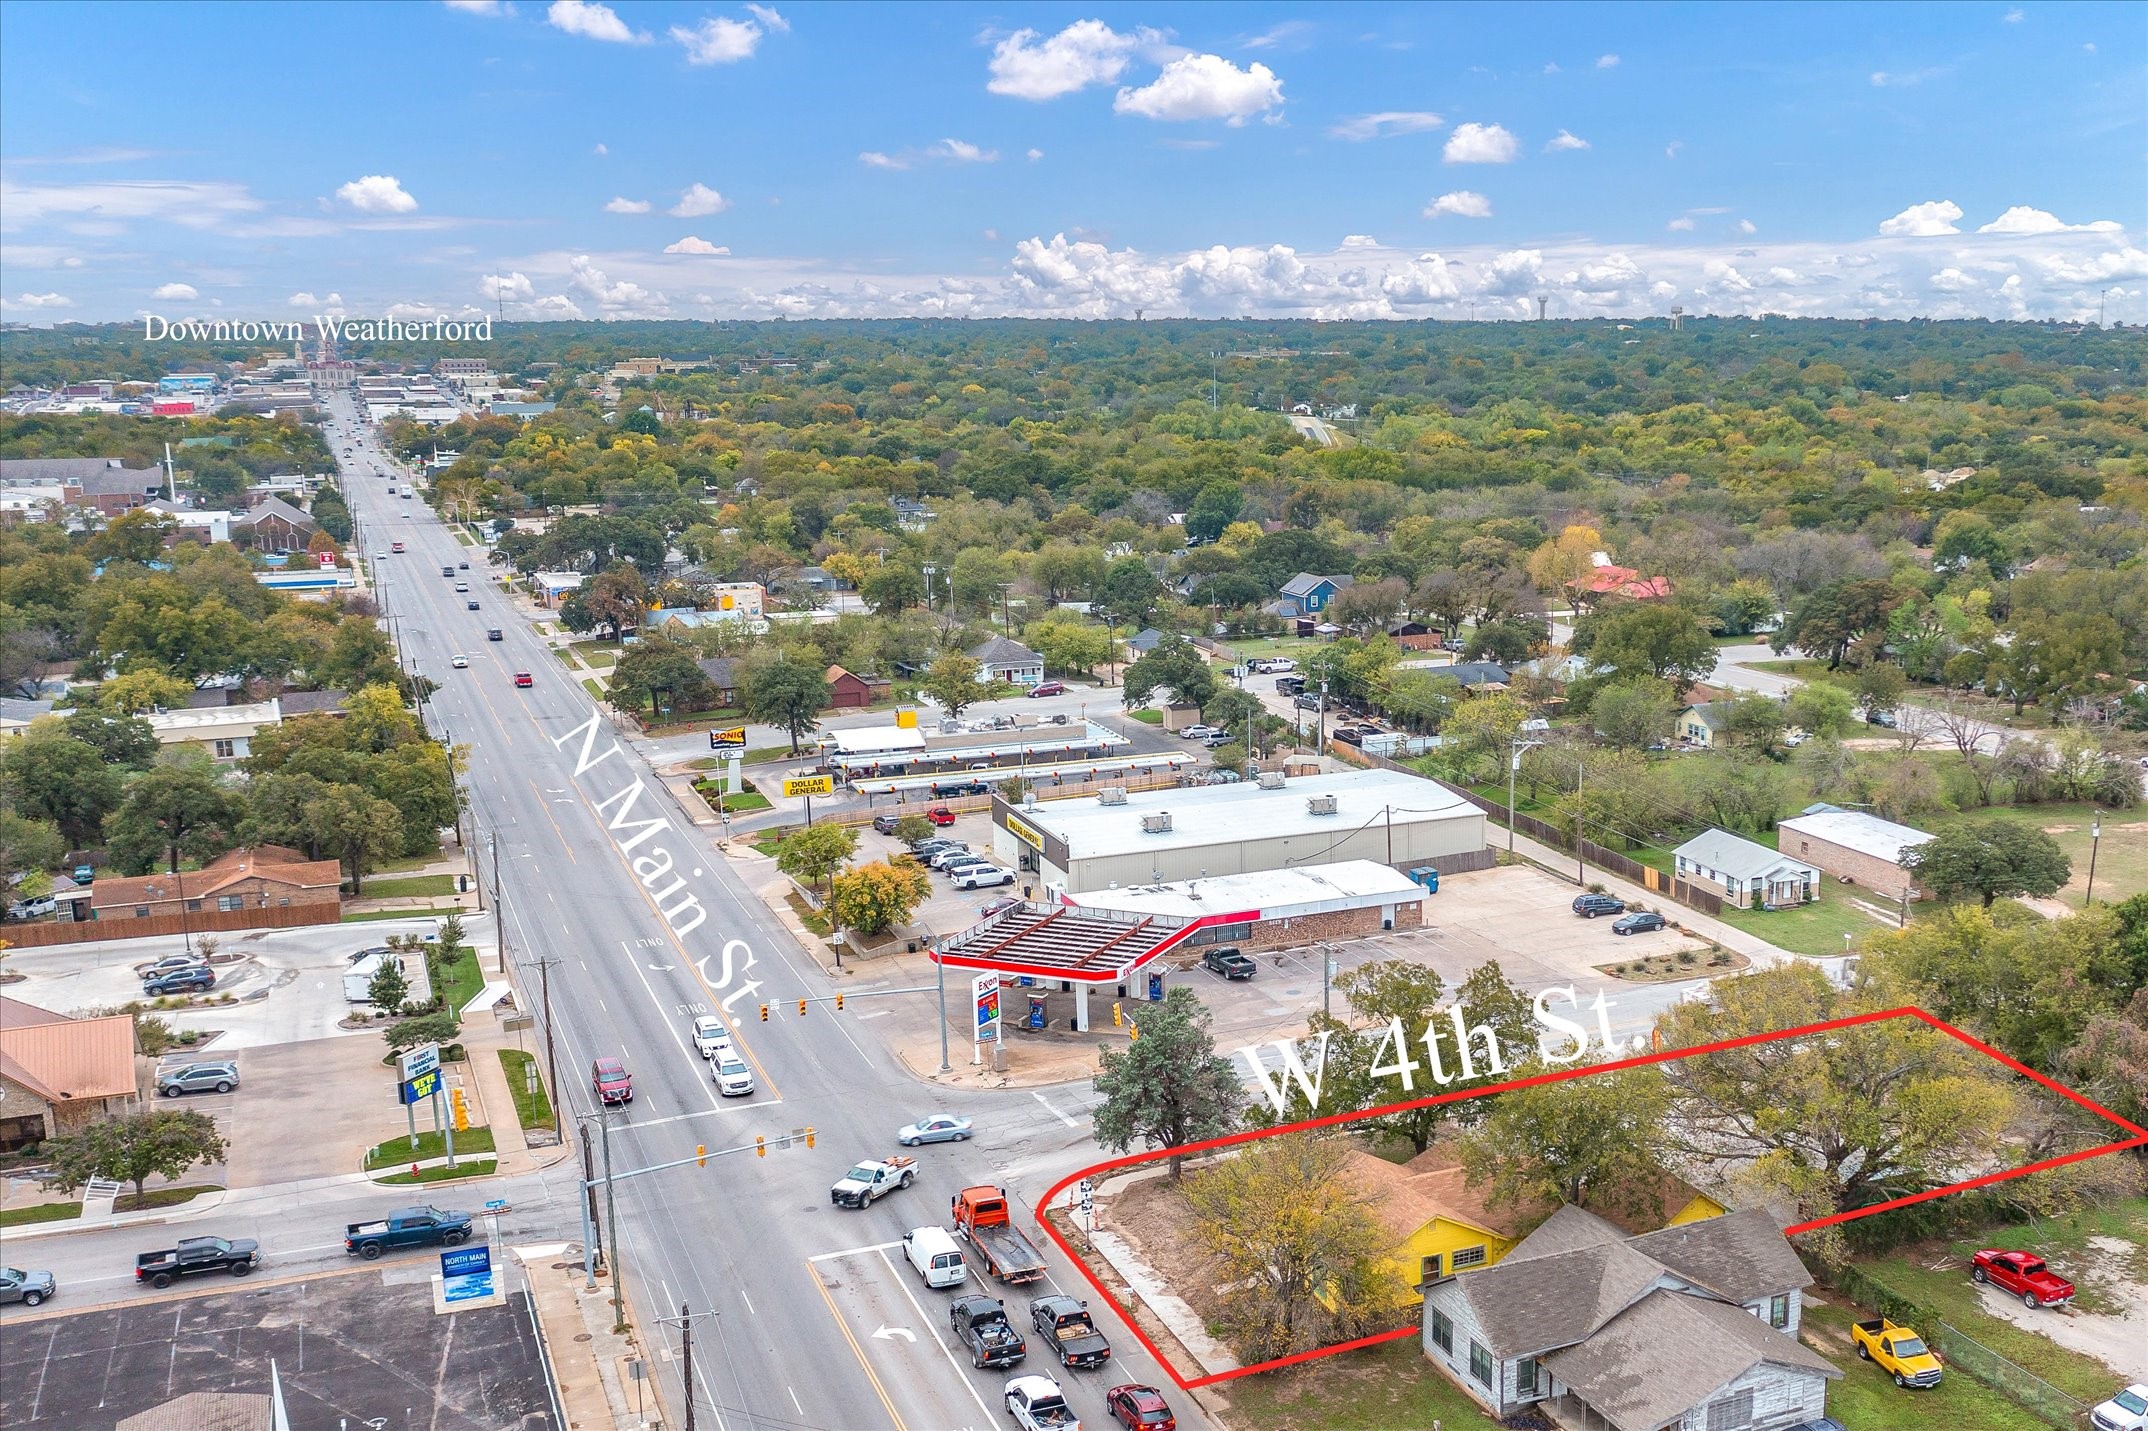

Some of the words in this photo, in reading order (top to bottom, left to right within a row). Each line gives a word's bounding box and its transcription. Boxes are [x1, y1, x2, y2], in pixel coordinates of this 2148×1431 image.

[714, 731, 742, 740] SONIC
[791, 779, 824, 788] DOLLAR
[789, 786, 826, 795] GENERAL
[635, 937, 664, 949] ONLY
[978, 976, 997, 991] Exxon
[675, 1002, 708, 1016] ONLY
[407, 1056, 436, 1072] FINANCIAL
[414, 1065, 431, 1075] BANK
[412, 1073, 436, 1090] WE'VE
[417, 1084, 432, 1098] GOT
[445, 1255, 468, 1266] NORTH
[469, 1253, 487, 1262] MAIN
